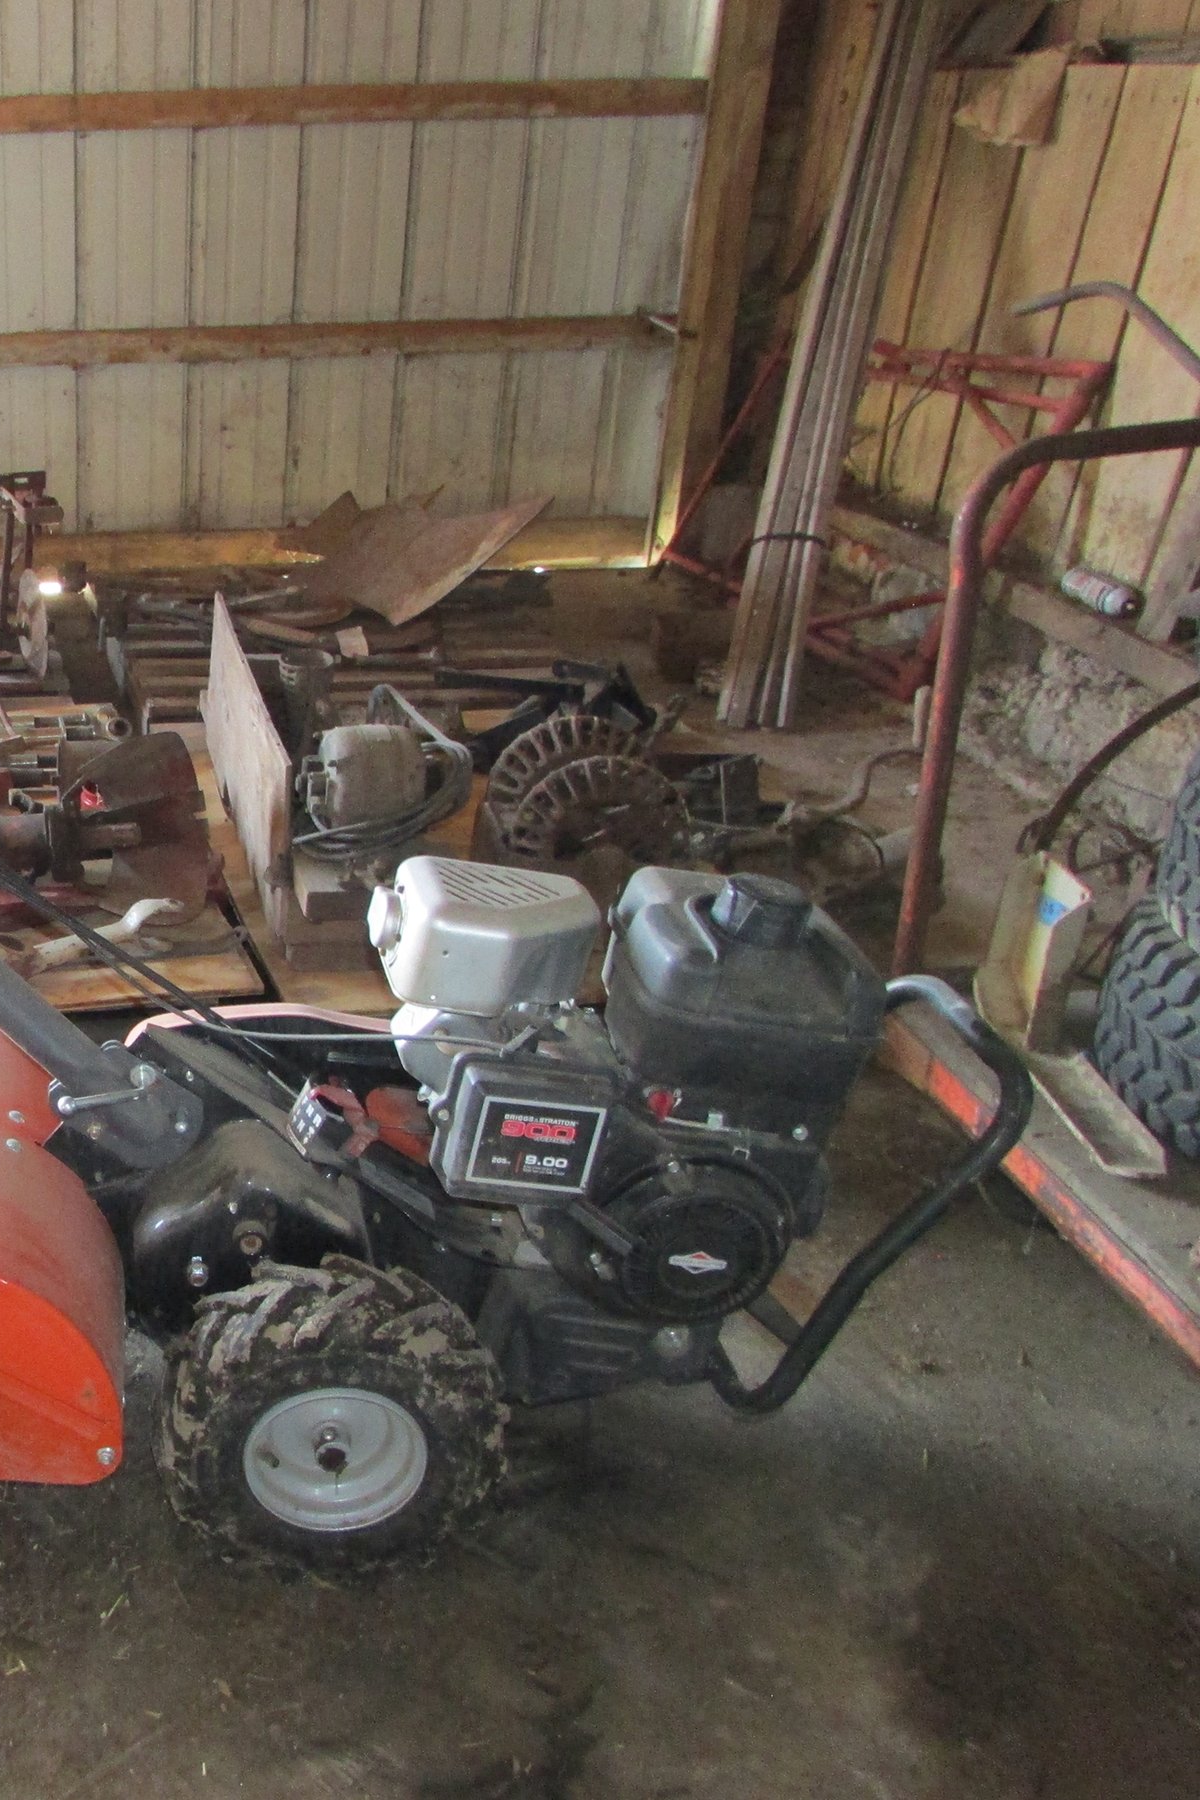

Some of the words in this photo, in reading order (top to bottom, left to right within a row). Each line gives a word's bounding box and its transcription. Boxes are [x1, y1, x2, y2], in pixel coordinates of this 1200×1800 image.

[504, 1113, 534, 1122] BRIGGS
[539, 1117, 576, 1127] STRATTON
[501, 1120, 576, 1140] 900
[525, 1154, 568, 1168] 9.00
